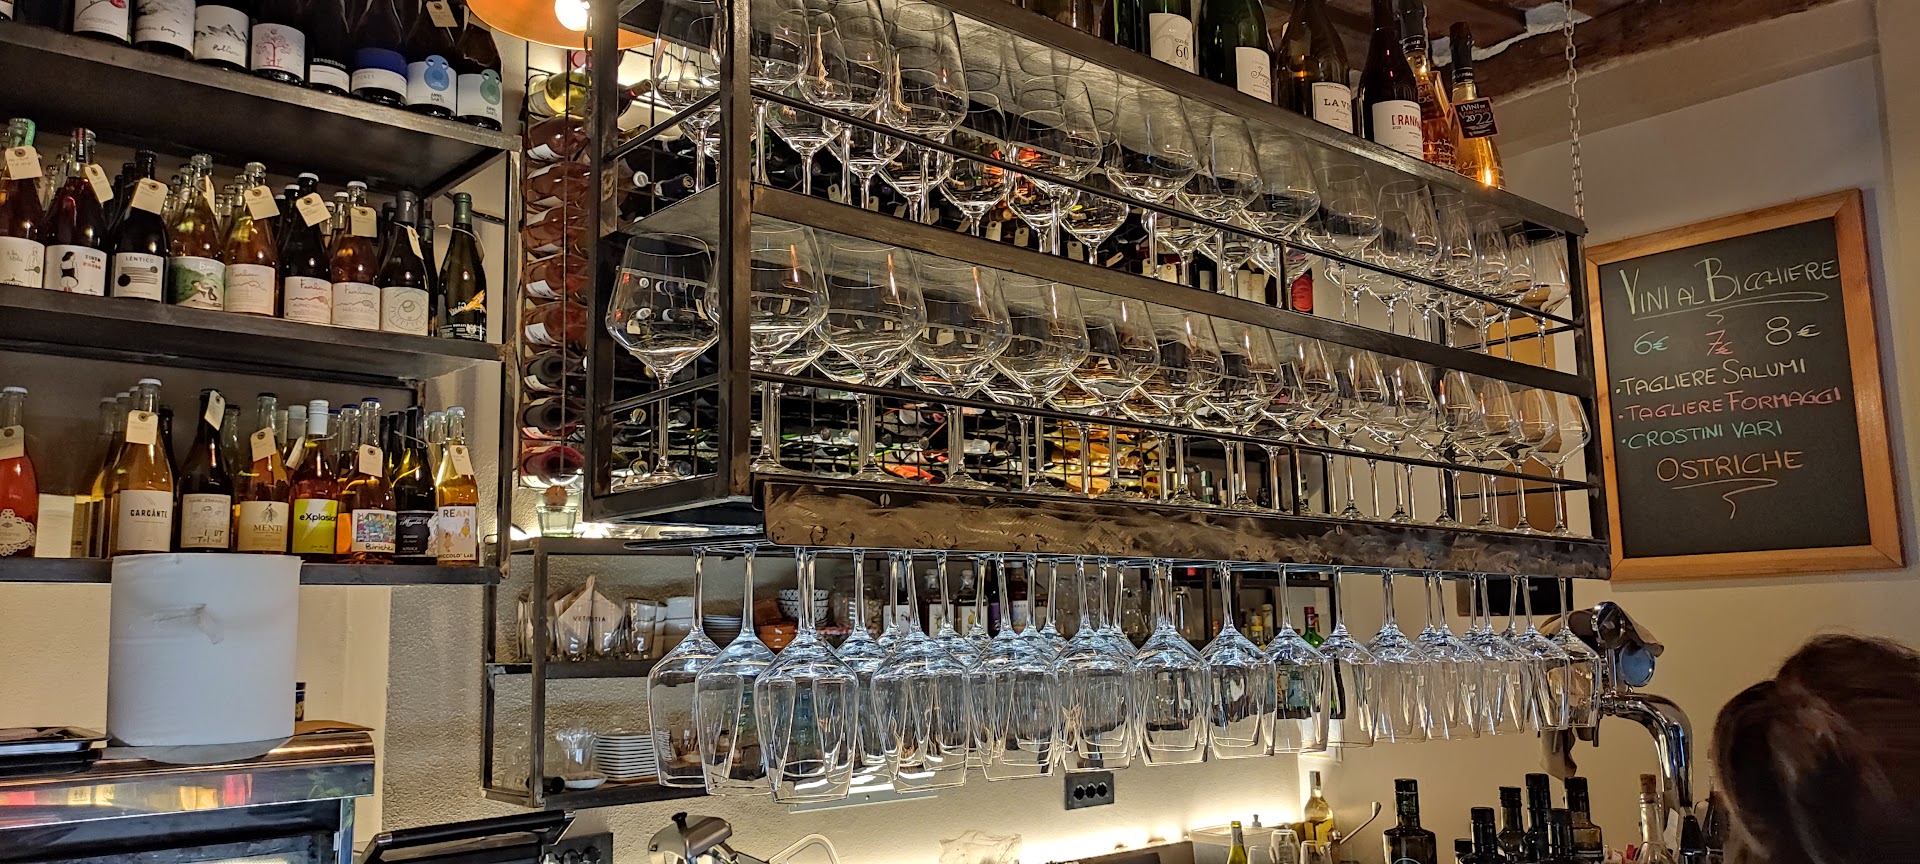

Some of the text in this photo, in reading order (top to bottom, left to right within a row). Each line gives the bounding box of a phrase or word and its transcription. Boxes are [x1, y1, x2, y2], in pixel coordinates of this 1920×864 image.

[1176, 45, 1189, 60] 60
[1465, 112, 1493, 126] 2022
[1619, 257, 1839, 315] VINI AL BICCHIERE
[1633, 330, 1670, 355] 6€
[1619, 358, 1807, 396] TAGLIERE SALUMI
[1624, 386, 1842, 422] TAGLIERE FORMAGGI
[1627, 420, 1783, 449] CROSTINI VARI
[1656, 450, 1804, 482] OSTRICHE
[253, 524, 283, 532] MENTI
